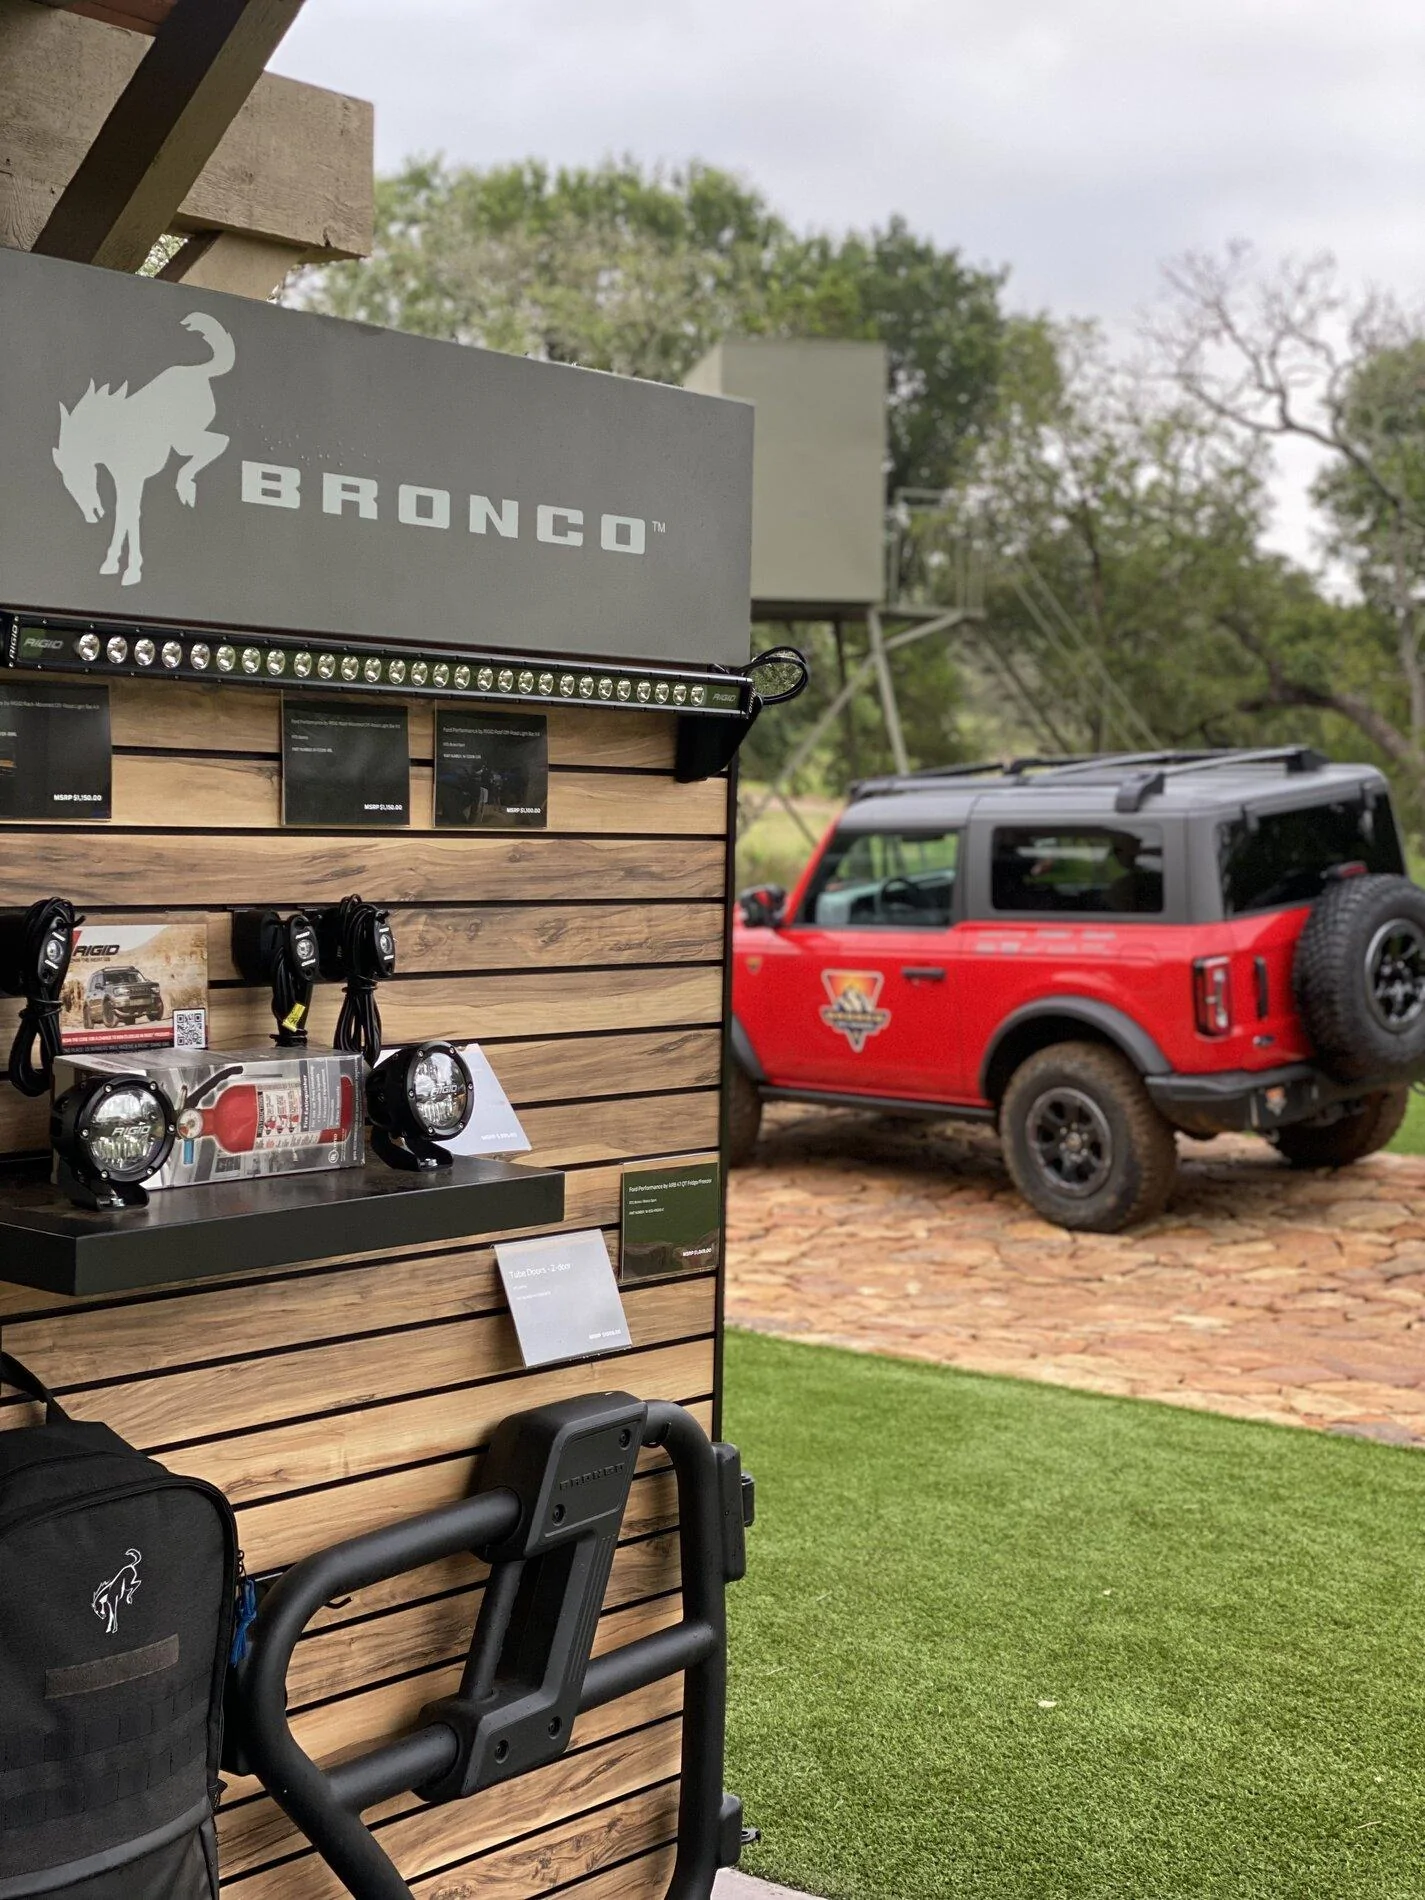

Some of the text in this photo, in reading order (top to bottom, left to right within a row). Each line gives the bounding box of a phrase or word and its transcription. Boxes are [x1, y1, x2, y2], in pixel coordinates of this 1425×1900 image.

[241, 459, 646, 555] BRONCO
[24, 637, 64, 649] RIGID
[73, 944, 120, 956] RIGID
[430, 1083, 458, 1100] RIGID
[111, 1125, 151, 1136] RIGID
[508, 1270, 527, 1279] Tube
[527, 1266, 547, 1278] Doors
